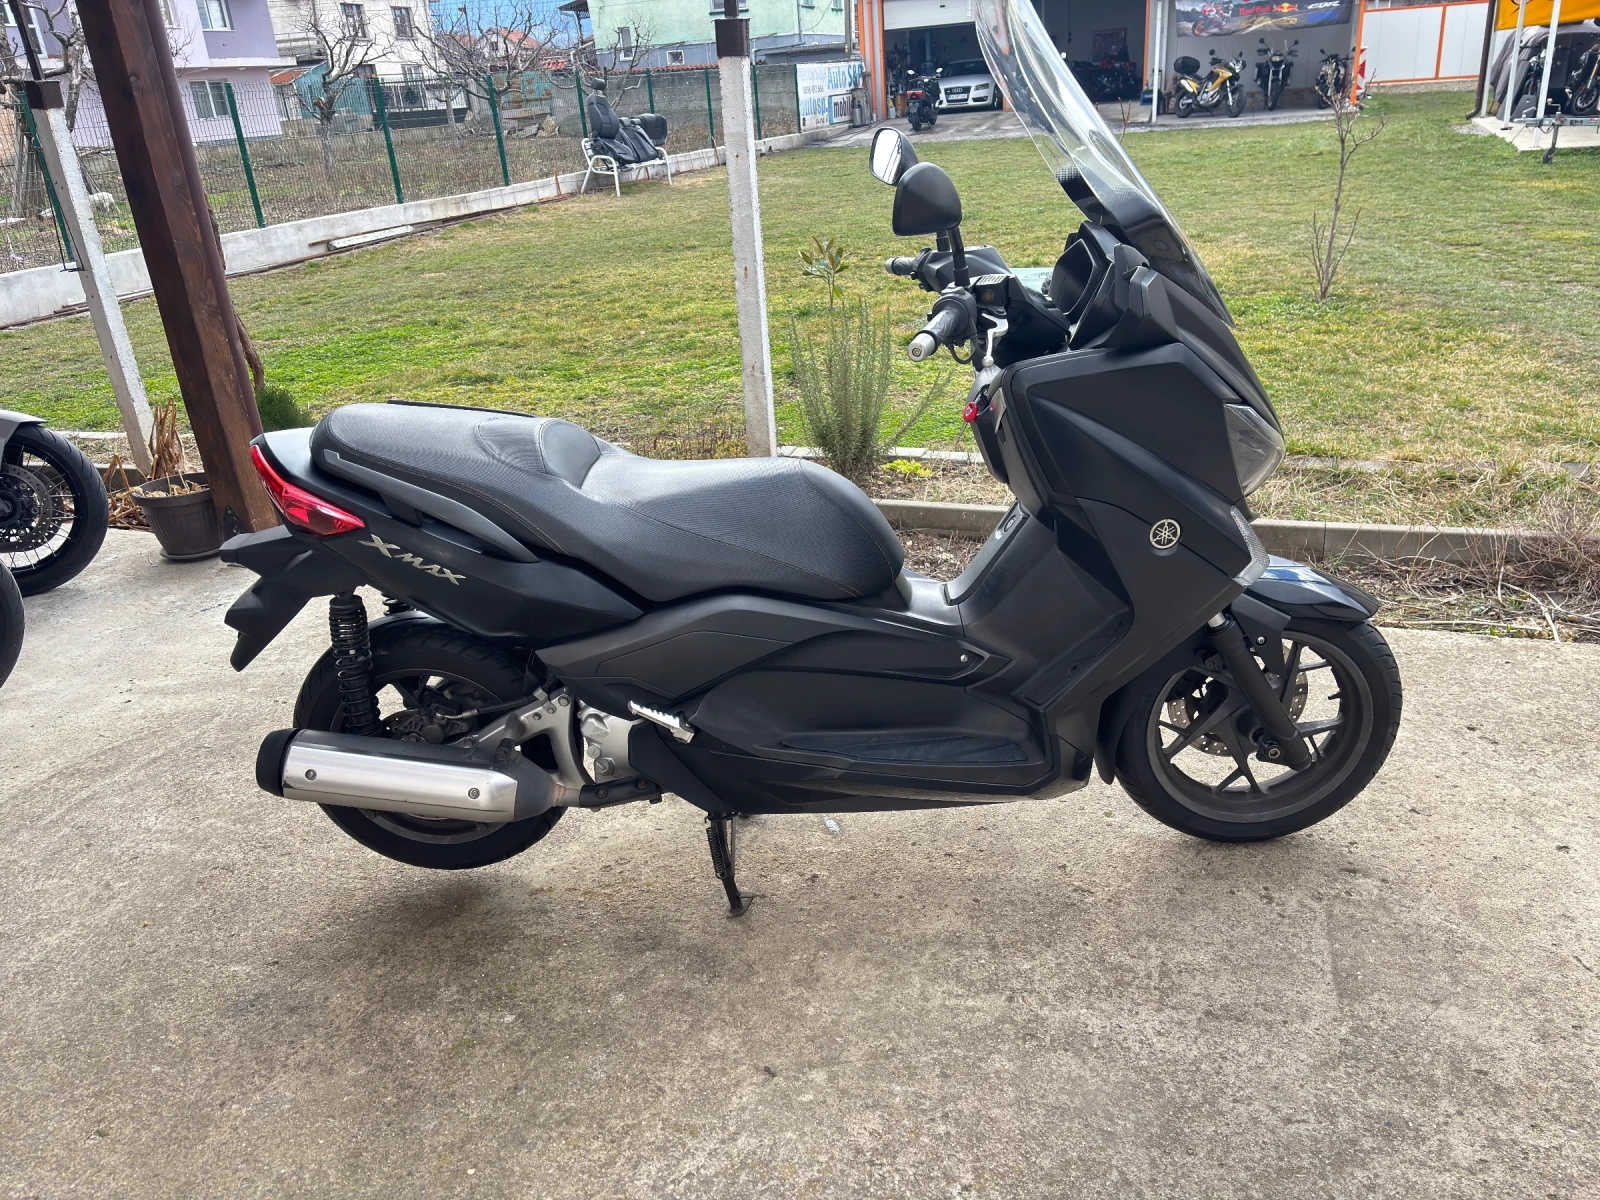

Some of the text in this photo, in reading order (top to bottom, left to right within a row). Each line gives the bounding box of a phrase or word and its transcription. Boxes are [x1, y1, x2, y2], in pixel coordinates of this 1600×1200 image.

[1239, 4, 1271, 16] Red Bull
[827, 63, 863, 90] Auto S&P
